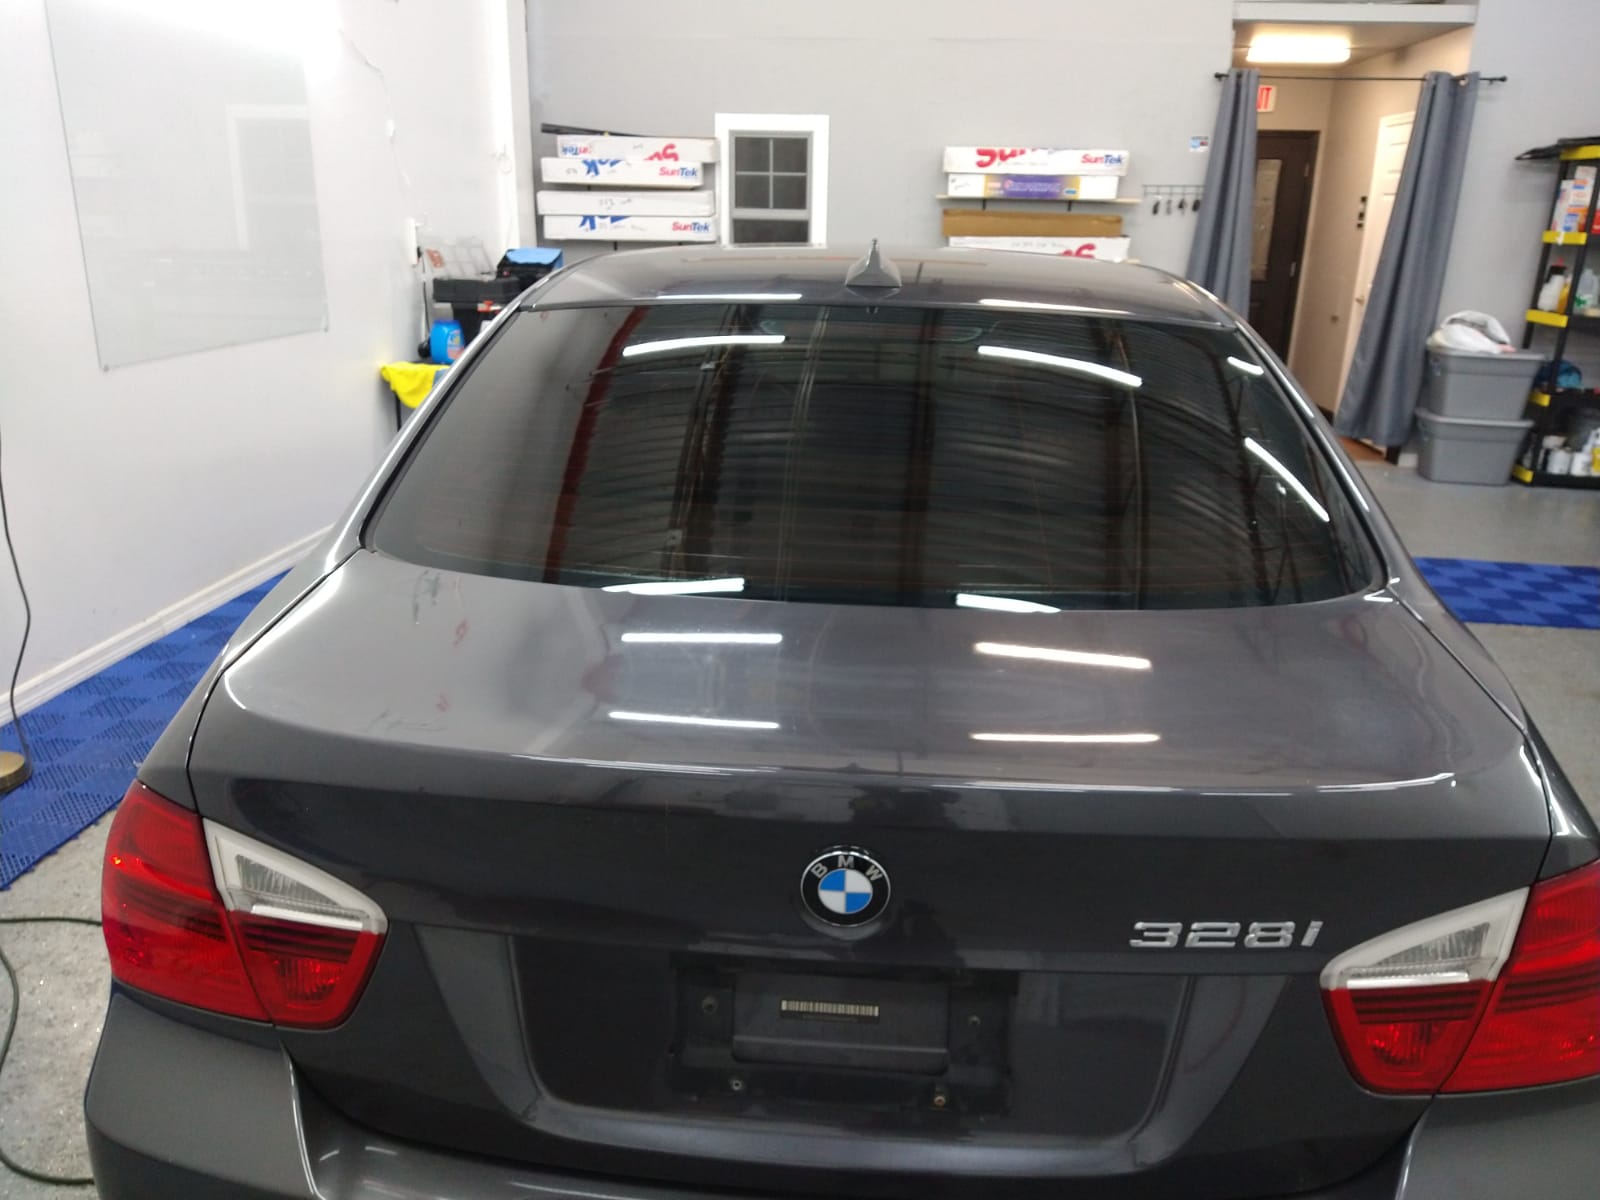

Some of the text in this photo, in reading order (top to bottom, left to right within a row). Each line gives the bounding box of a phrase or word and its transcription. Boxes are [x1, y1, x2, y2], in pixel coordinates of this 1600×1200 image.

[1081, 153, 1122, 165] SunTek
[659, 166, 698, 178] SunTek
[672, 222, 710, 233] SunTek
[810, 854, 883, 881] BMW
[1129, 920, 1324, 948] 328i
